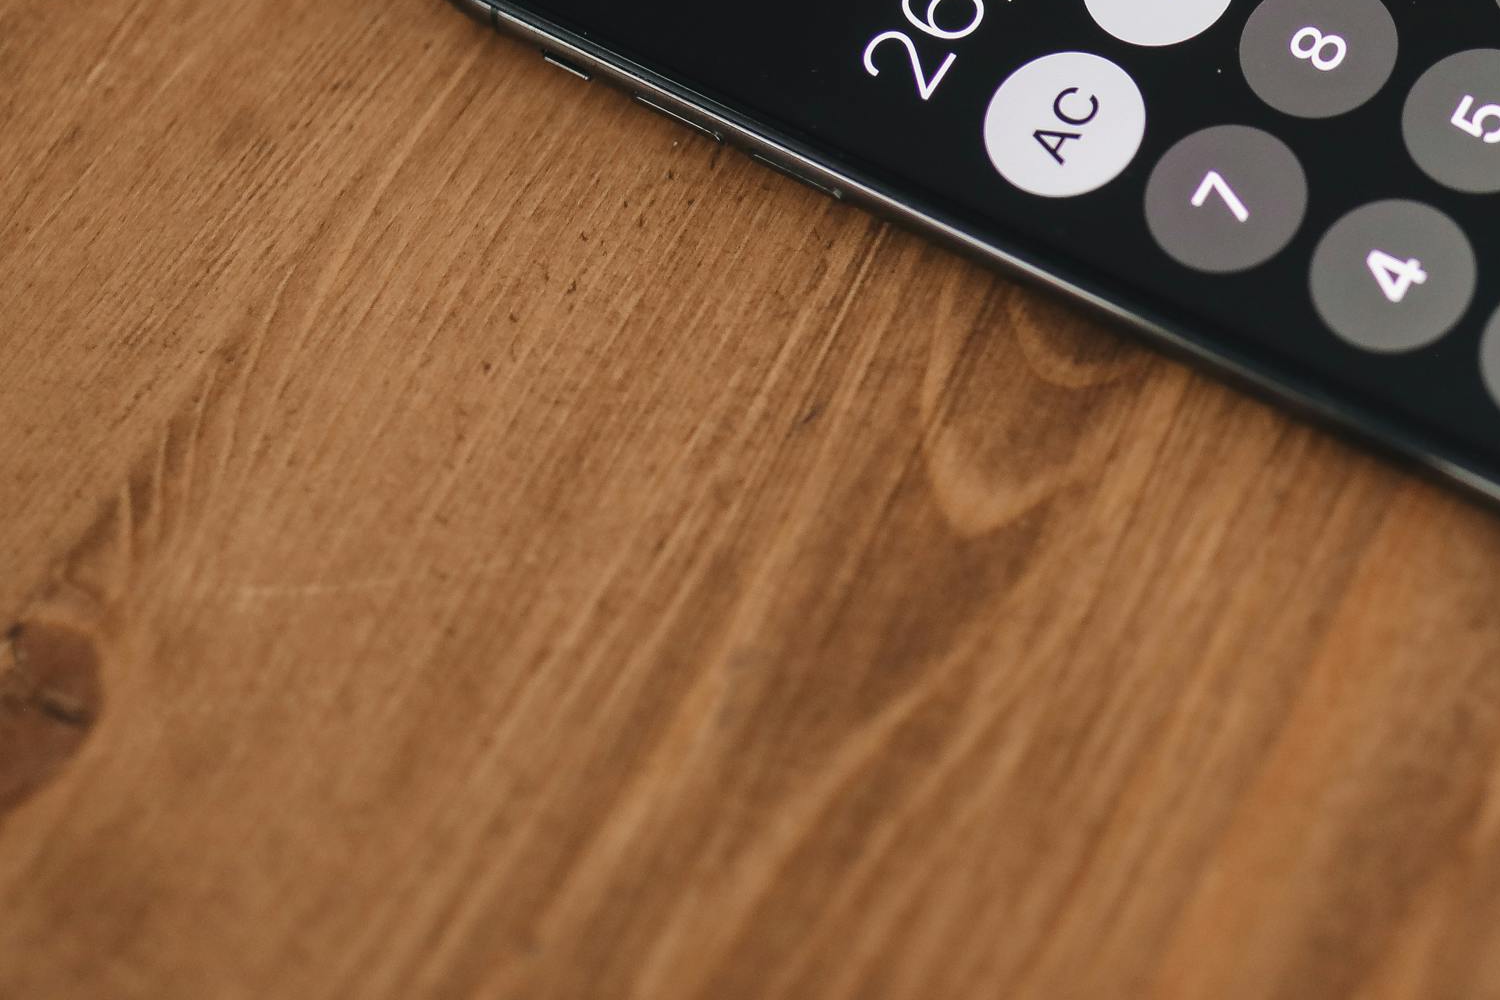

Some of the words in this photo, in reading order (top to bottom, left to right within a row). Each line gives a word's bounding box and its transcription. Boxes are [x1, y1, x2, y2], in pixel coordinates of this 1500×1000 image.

[1290, 26, 1347, 71] 8
[1032, 86, 1100, 166] AC
[1191, 171, 1249, 222] 7
[1366, 250, 1427, 302] 4
